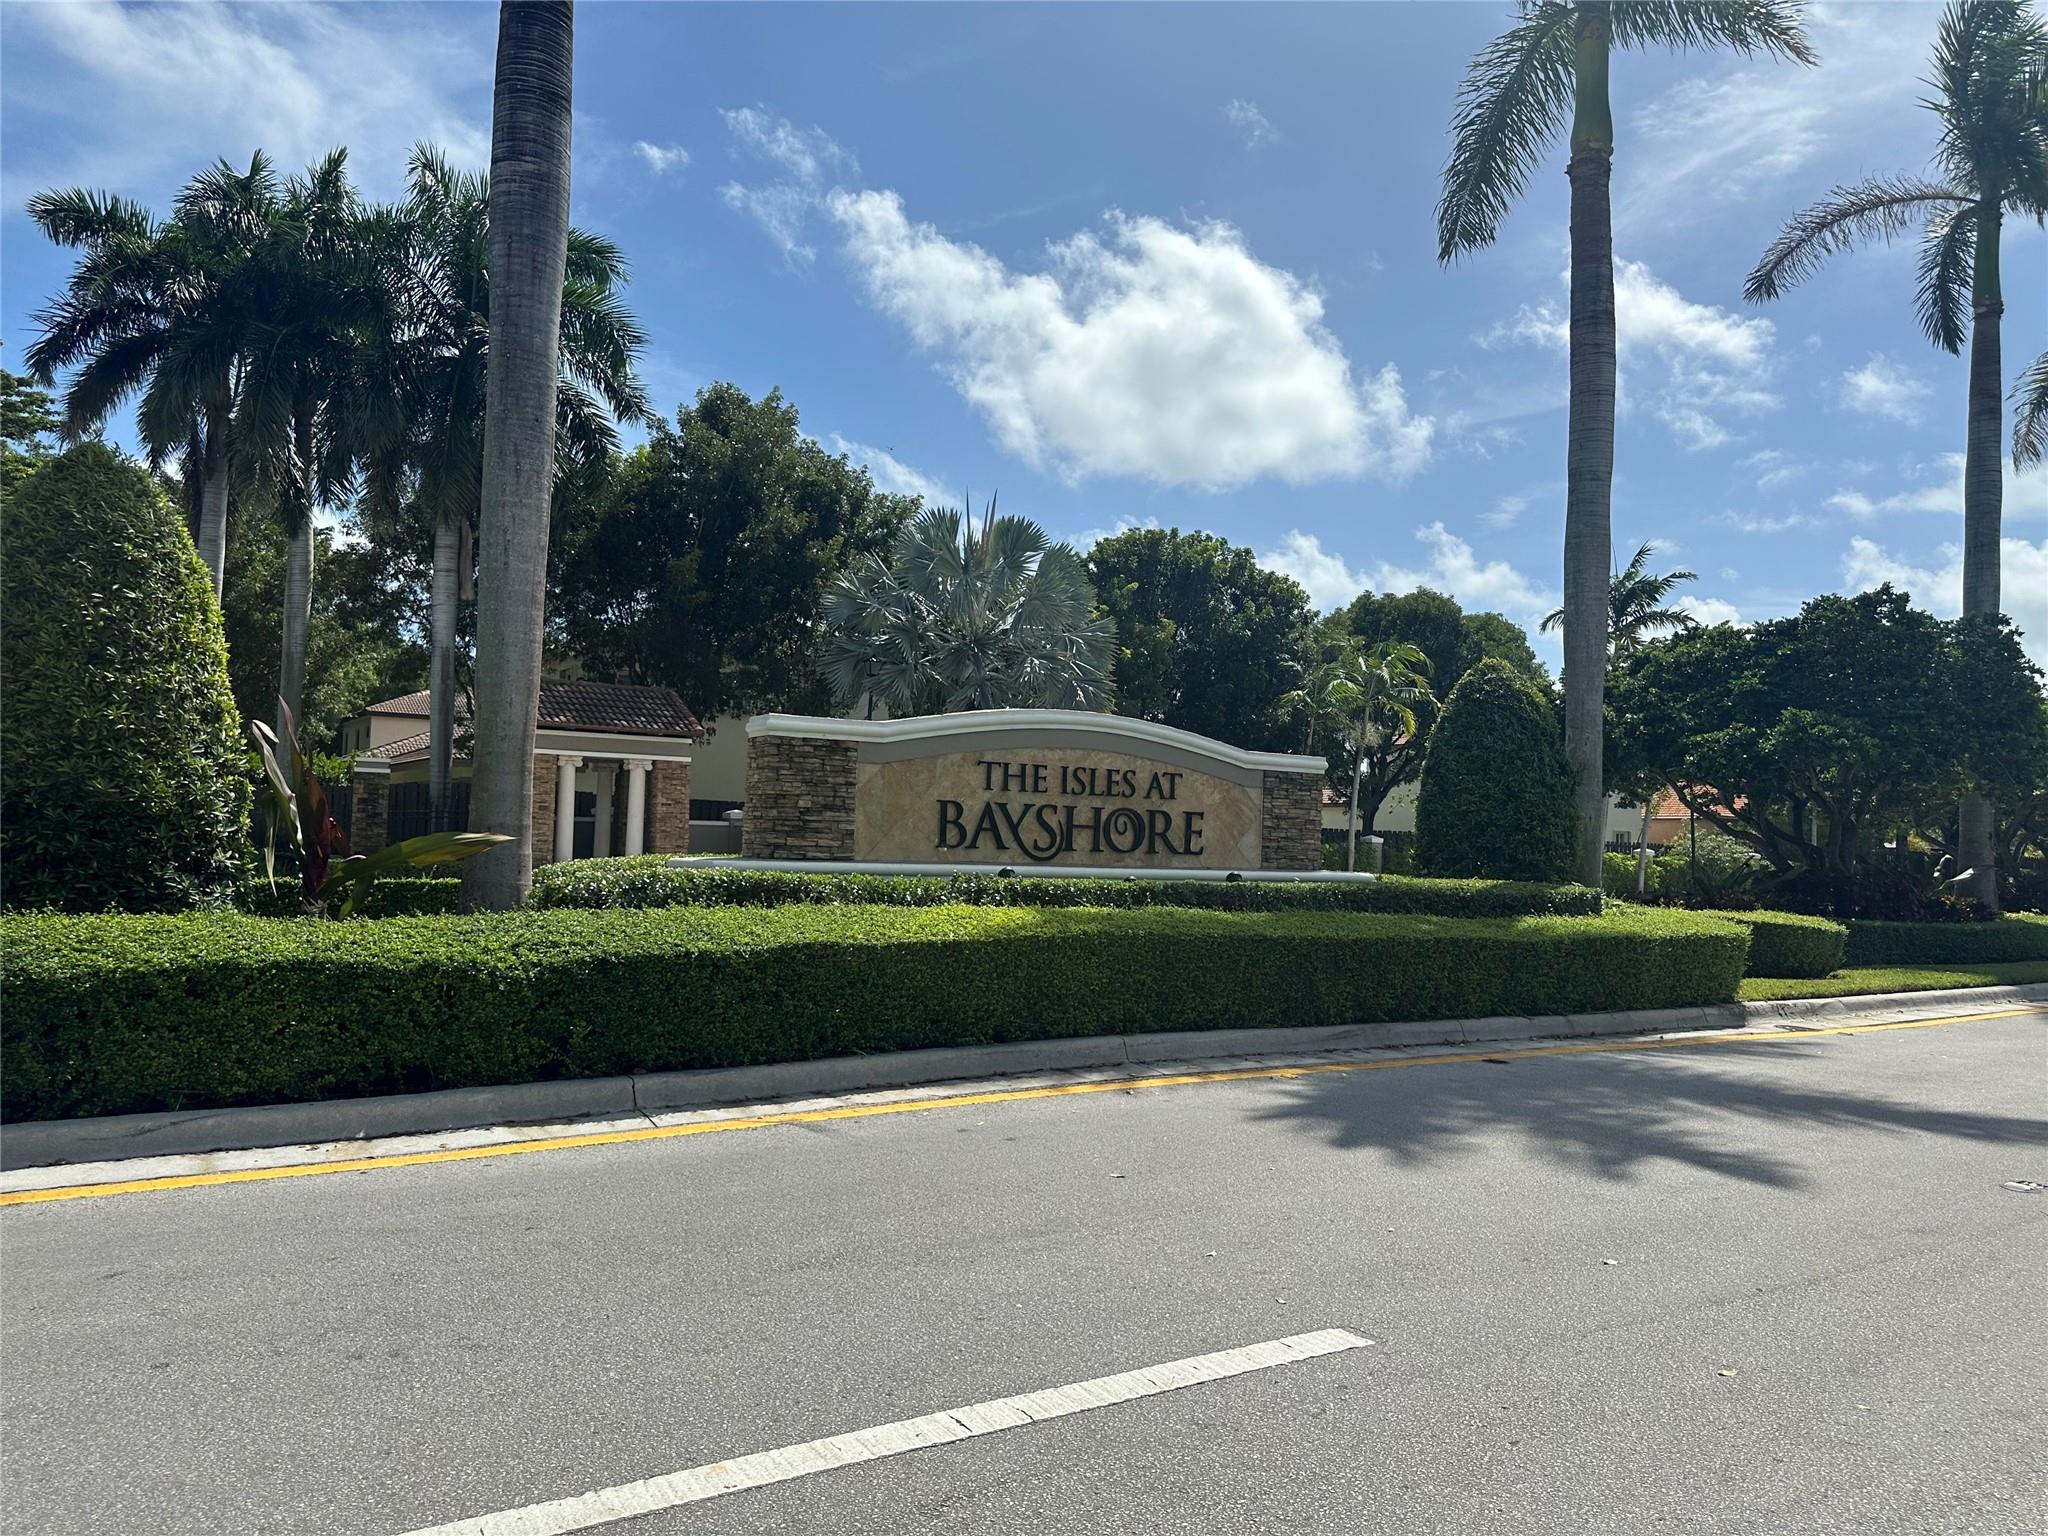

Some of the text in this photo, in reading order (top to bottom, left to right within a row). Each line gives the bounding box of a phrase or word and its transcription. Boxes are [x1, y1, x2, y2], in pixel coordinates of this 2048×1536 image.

[977, 760, 1183, 799] THE ISLES AT
[936, 799, 1205, 861] BAYSHORE
